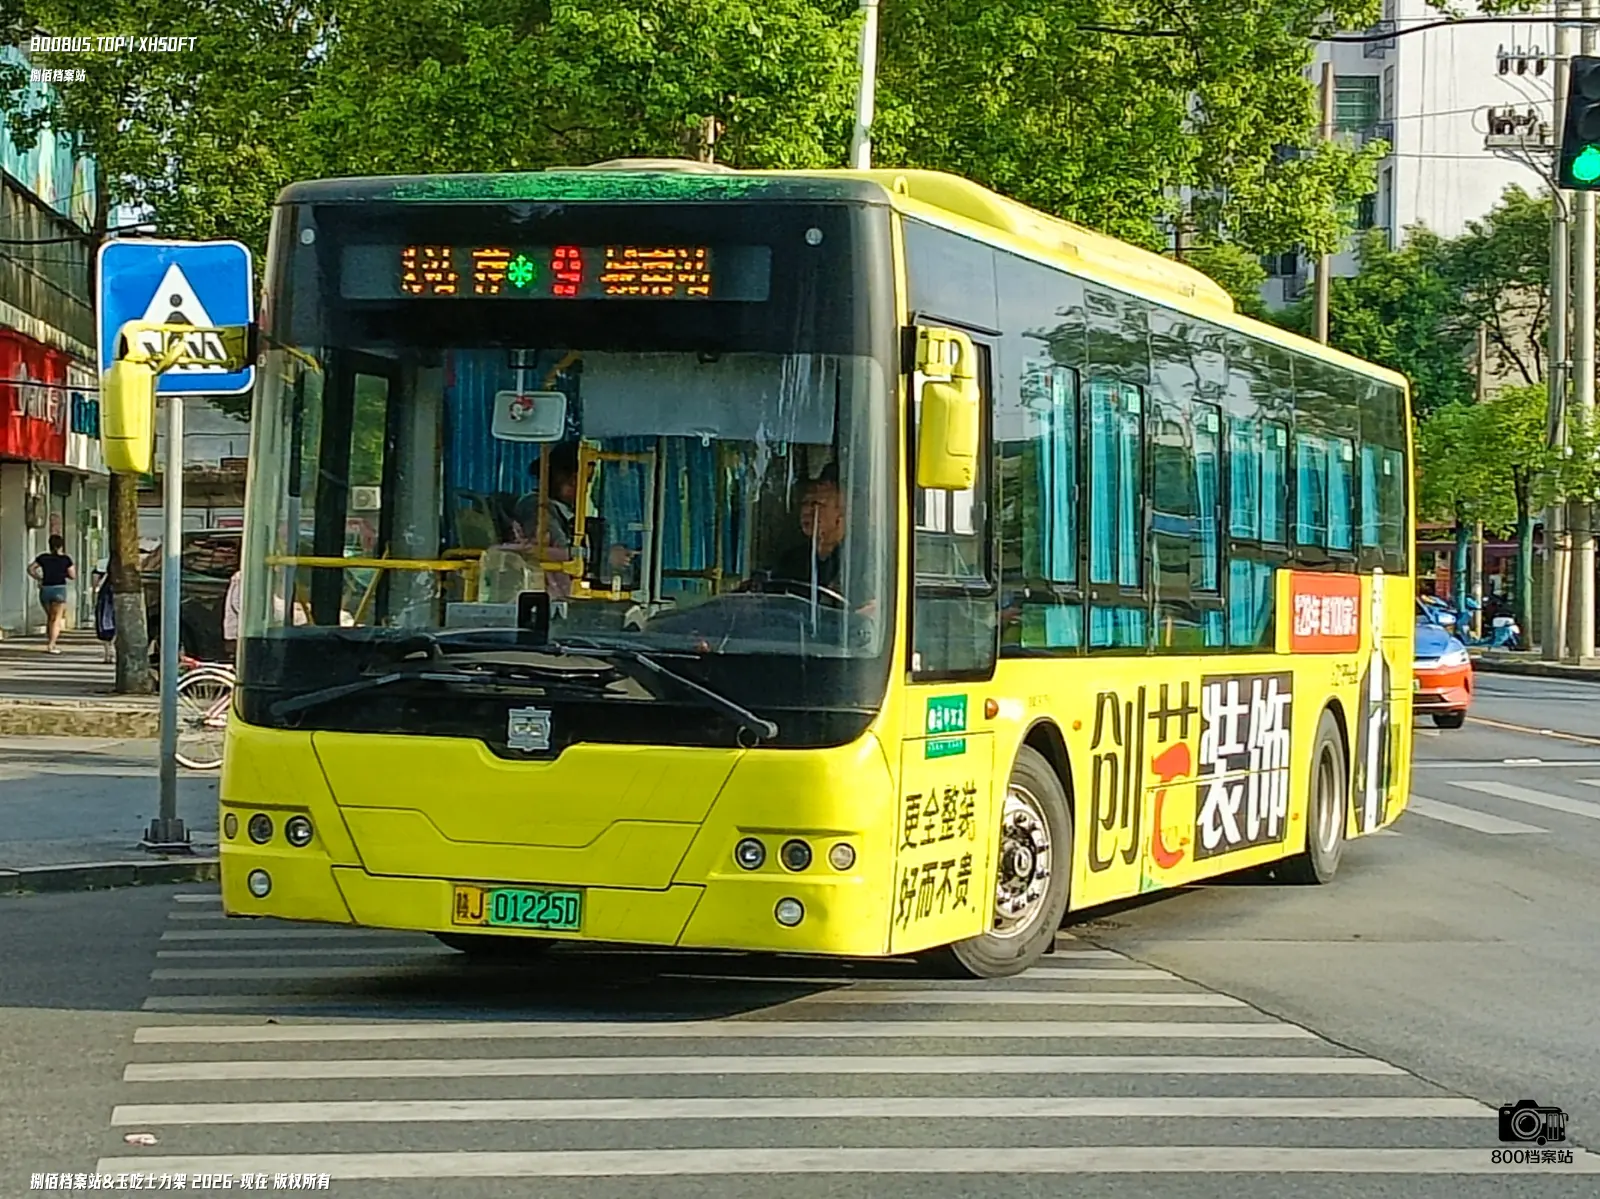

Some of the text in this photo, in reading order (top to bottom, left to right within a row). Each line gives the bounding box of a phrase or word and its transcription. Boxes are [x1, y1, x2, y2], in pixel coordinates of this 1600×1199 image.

[1090, 677, 1292, 871] 创艺装饰
[495, 893, 578, 925] 01225D
